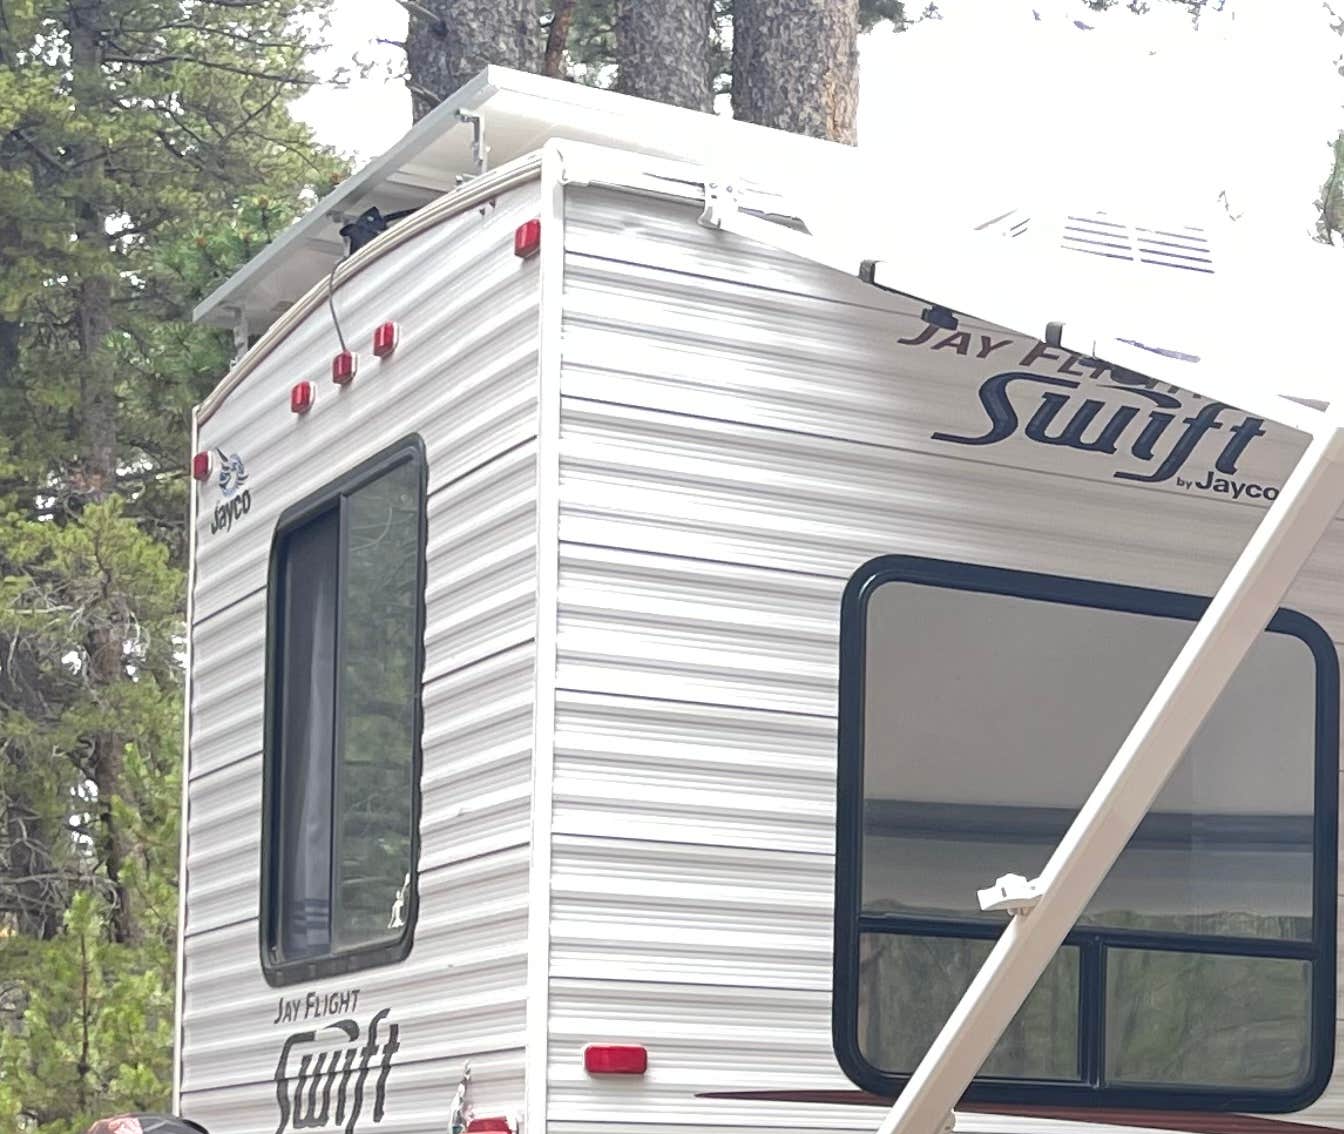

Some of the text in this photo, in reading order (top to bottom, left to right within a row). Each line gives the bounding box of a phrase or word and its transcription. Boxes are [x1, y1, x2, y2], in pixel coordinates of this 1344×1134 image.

[897, 324, 1014, 359] JAY
[930, 371, 1267, 483] Swift
[1176, 471, 1281, 501] by Jayco
[210, 489, 251, 536] Jayco
[274, 989, 361, 1025] JAY FLIGHT
